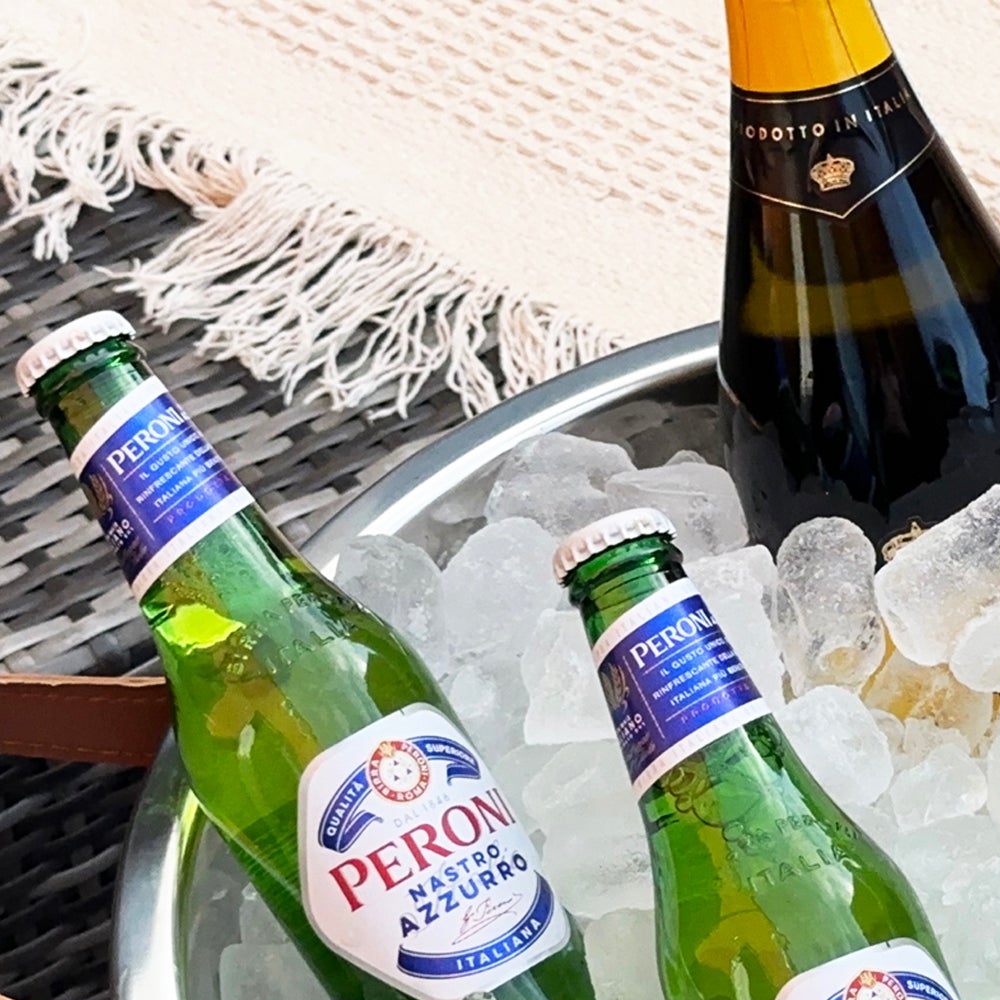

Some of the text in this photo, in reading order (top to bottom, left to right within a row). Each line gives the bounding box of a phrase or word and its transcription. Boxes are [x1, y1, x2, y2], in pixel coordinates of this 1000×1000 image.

[834, 114, 857, 133] IN
[106, 407, 184, 476] PERONI
[139, 471, 149, 480] IL
[150, 446, 179, 472] GUSTO
[135, 452, 196, 504] RINFRESCANTE
[154, 476, 193, 508] ITALIANA
[629, 608, 713, 669] PERONI
[660, 667, 670, 677] IL
[671, 647, 705, 670] GUSTO
[652, 656, 719, 700] RINFRESCANTE
[669, 678, 713, 706] ITALIANA
[326, 779, 364, 837] QUALITÀ
[397, 782, 428, 801] ROMA
[328, 787, 517, 912] PERONI
[408, 844, 500, 903] NASTRO
[400, 853, 528, 938] AZZURRO
[456, 918, 542, 971] ITALIANA
